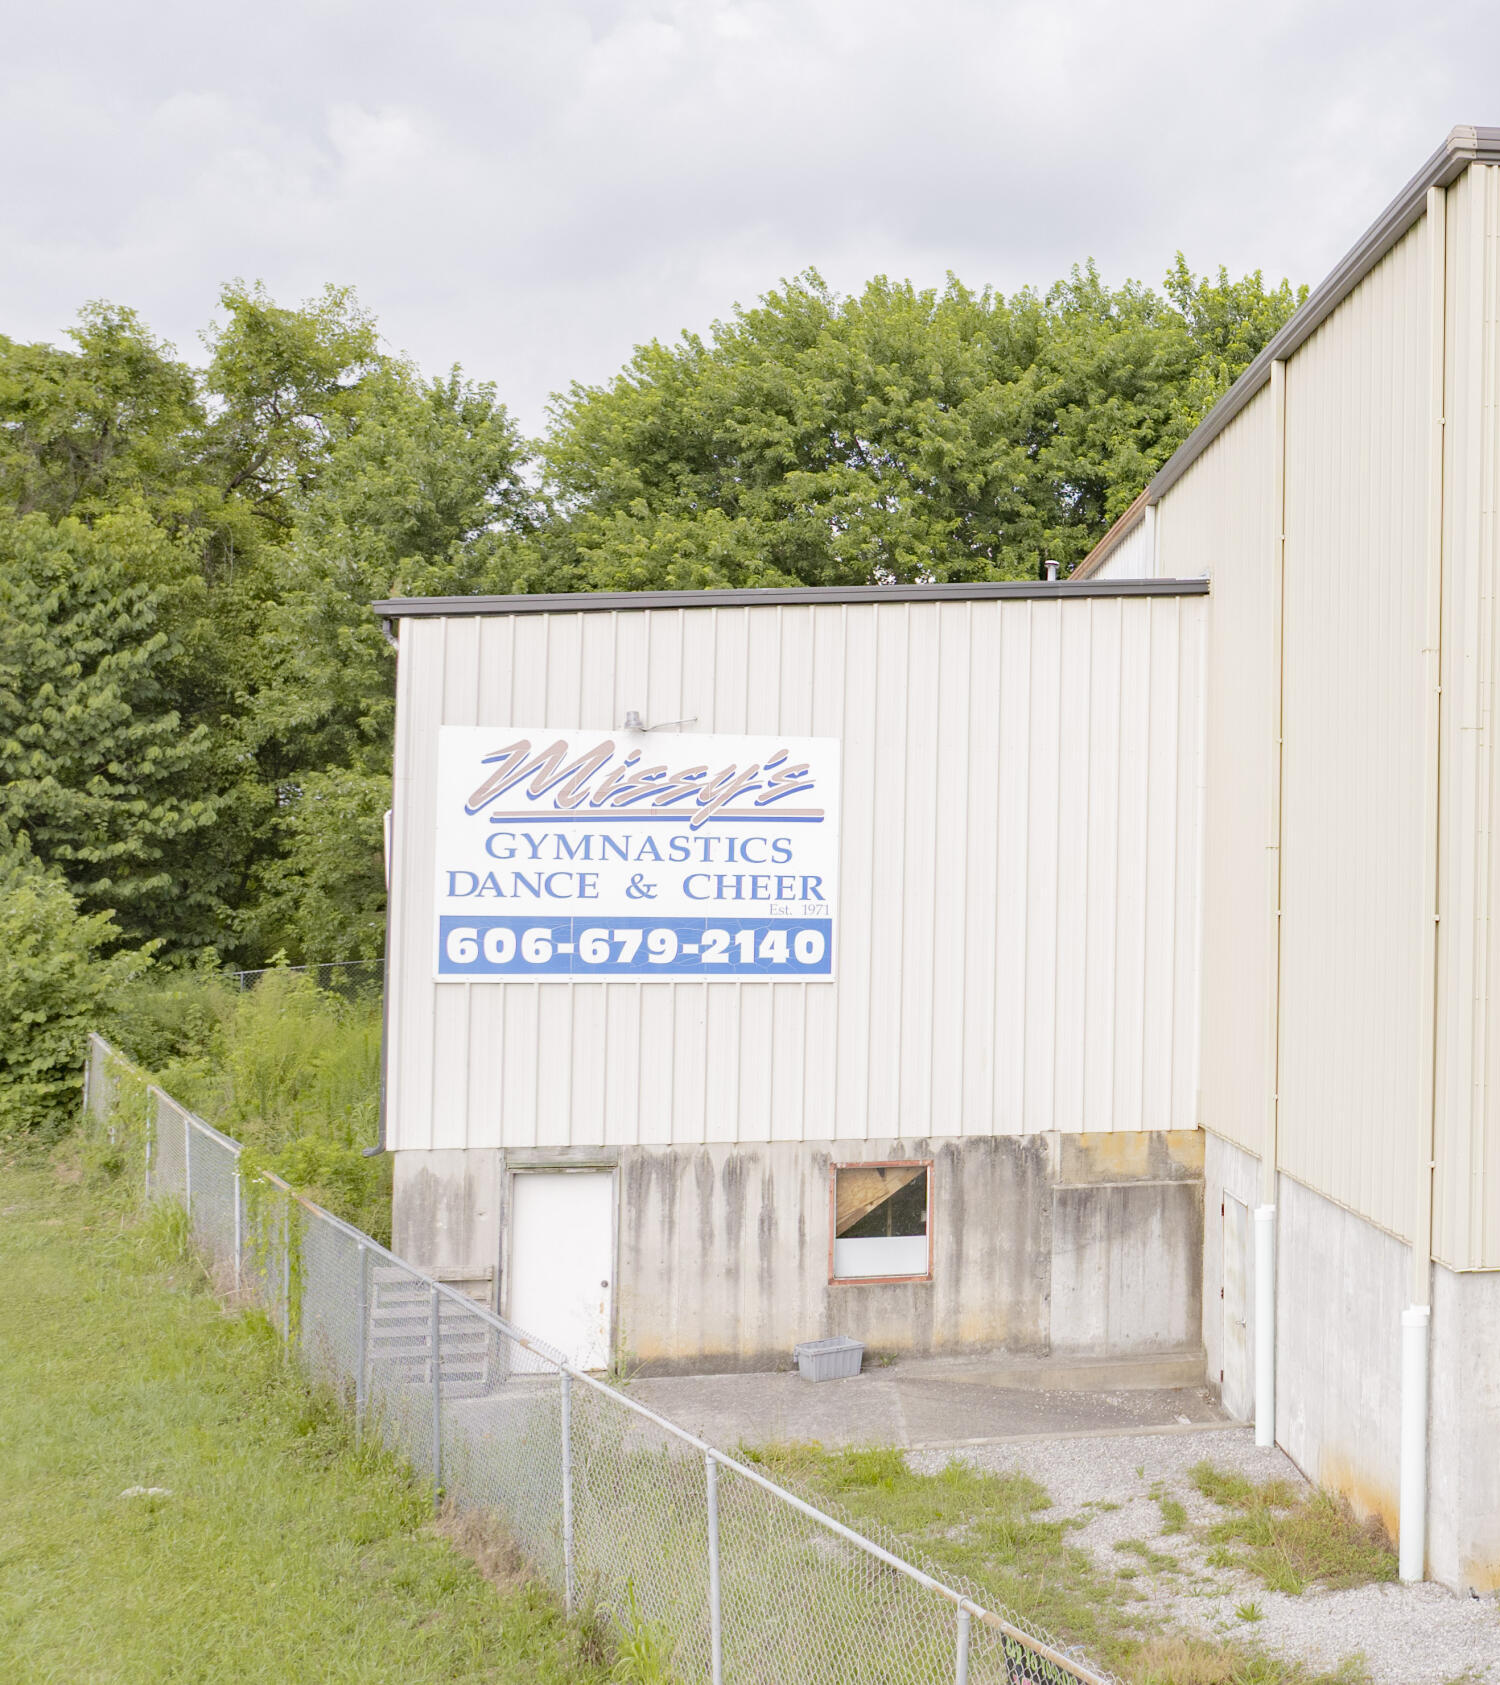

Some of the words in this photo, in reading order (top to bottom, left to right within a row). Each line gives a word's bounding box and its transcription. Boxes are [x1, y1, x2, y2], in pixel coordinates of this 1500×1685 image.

[464, 739, 816, 831] Missy's
[484, 832, 793, 863] GYMNASTICS
[446, 870, 599, 899] DANCE
[625, 873, 658, 899] &
[683, 873, 826, 901] CHEER
[769, 903, 793, 916] Est.
[802, 903, 830, 916] 1971
[446, 927, 825, 964] 606-679-2140
